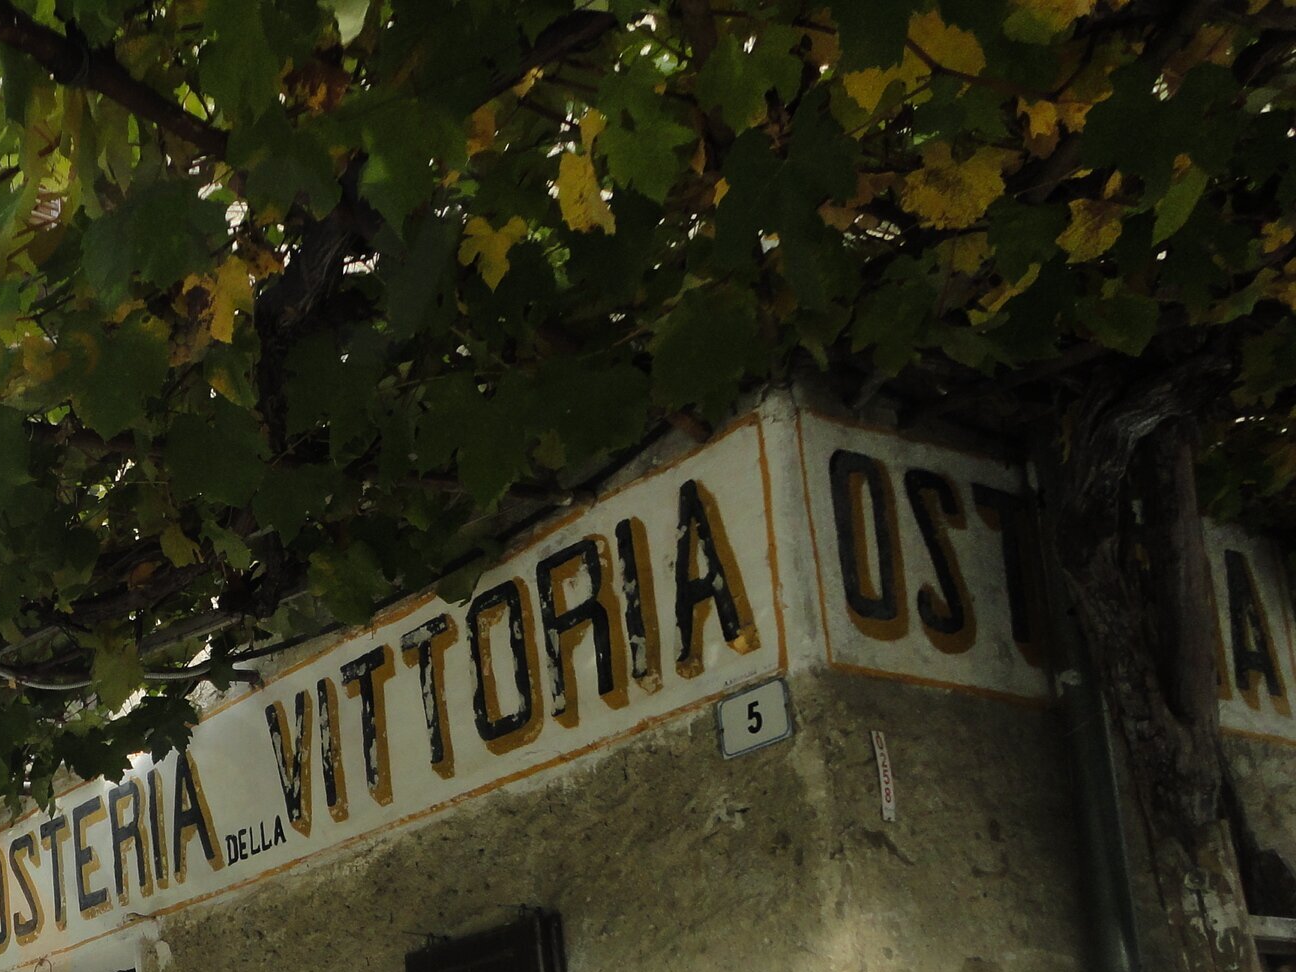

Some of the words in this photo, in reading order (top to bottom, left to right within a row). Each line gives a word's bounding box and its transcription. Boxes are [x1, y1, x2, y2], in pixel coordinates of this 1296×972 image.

[224, 815, 286, 866] DELLA
[265, 478, 760, 838] VITTORIA
[746, 701, 763, 734] 5
